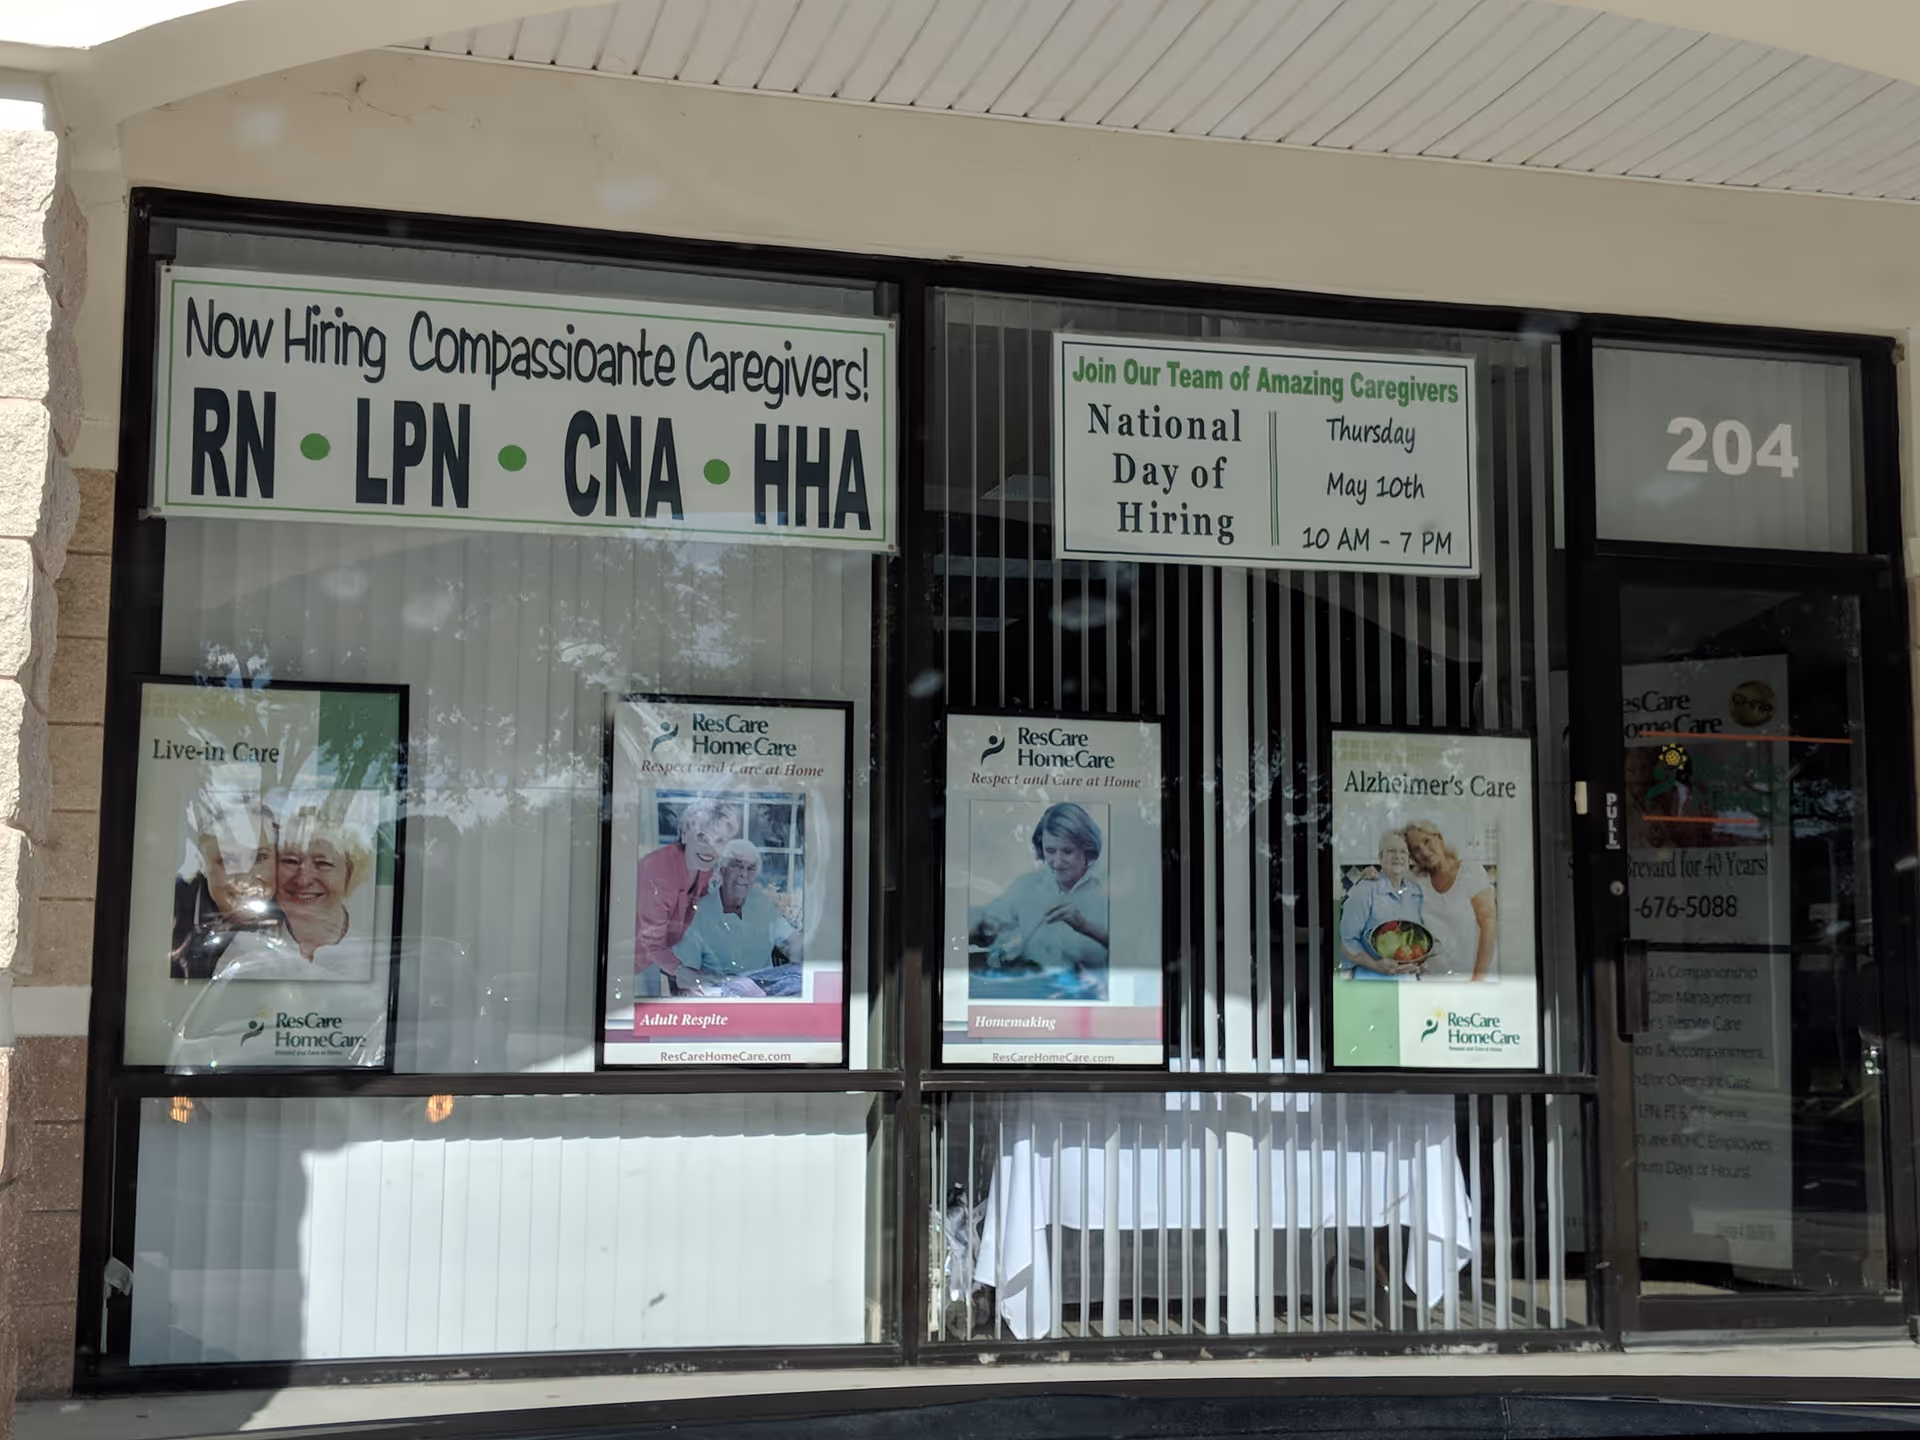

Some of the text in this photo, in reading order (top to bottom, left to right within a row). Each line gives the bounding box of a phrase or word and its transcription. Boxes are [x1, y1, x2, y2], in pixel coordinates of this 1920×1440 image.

[185, 297, 870, 410] Now Hiring Compassioante Caregivers!
[1072, 355, 1459, 407] Join Our Team of Amazing Caregivers
[1088, 403, 1243, 443] National
[1326, 415, 1416, 454] Thursday
[190, 387, 871, 531] RN LPN CNA HHA
[1666, 417, 1799, 478] 204
[1113, 453, 1227, 494] Day of
[1327, 472, 1425, 505] May 10th
[1117, 501, 1234, 546] Hiring
[1302, 528, 1331, 550] 10
[1337, 528, 1370, 552] AM
[1400, 531, 1413, 553] 7
[1422, 531, 1453, 555] PM
[1622, 690, 1691, 713] esCare
[692, 713, 769, 734] ResCare
[1624, 713, 1723, 738] omeCare
[692, 735, 797, 757] HomeCare
[1018, 727, 1088, 747] ResCare
[152, 738, 280, 763] Live-in Care
[1017, 748, 1115, 769] HomeCare
[641, 759, 693, 776] Respect
[697, 761, 725, 774] and
[765, 762, 780, 776] at
[784, 763, 824, 777] Home
[971, 772, 1141, 789] Respect and Care at Home
[1344, 769, 1516, 798] Alzheimer's Care
[1680, 851, 1701, 877] for
[1703, 852, 1722, 877] 40
[1634, 894, 1738, 919] -676-5088
[275, 1012, 342, 1029] ResCare
[640, 1013, 728, 1029] Adult Respite
[975, 1016, 1056, 1030] Homemaking
[1448, 1012, 1500, 1028] ResCare
[275, 1031, 366, 1048] HomeCare
[1448, 1029, 1520, 1045] HomeCare
[660, 1051, 791, 1062] ResCareHomeCare.com
[992, 1052, 1115, 1063] ResCareHomeCare.com
